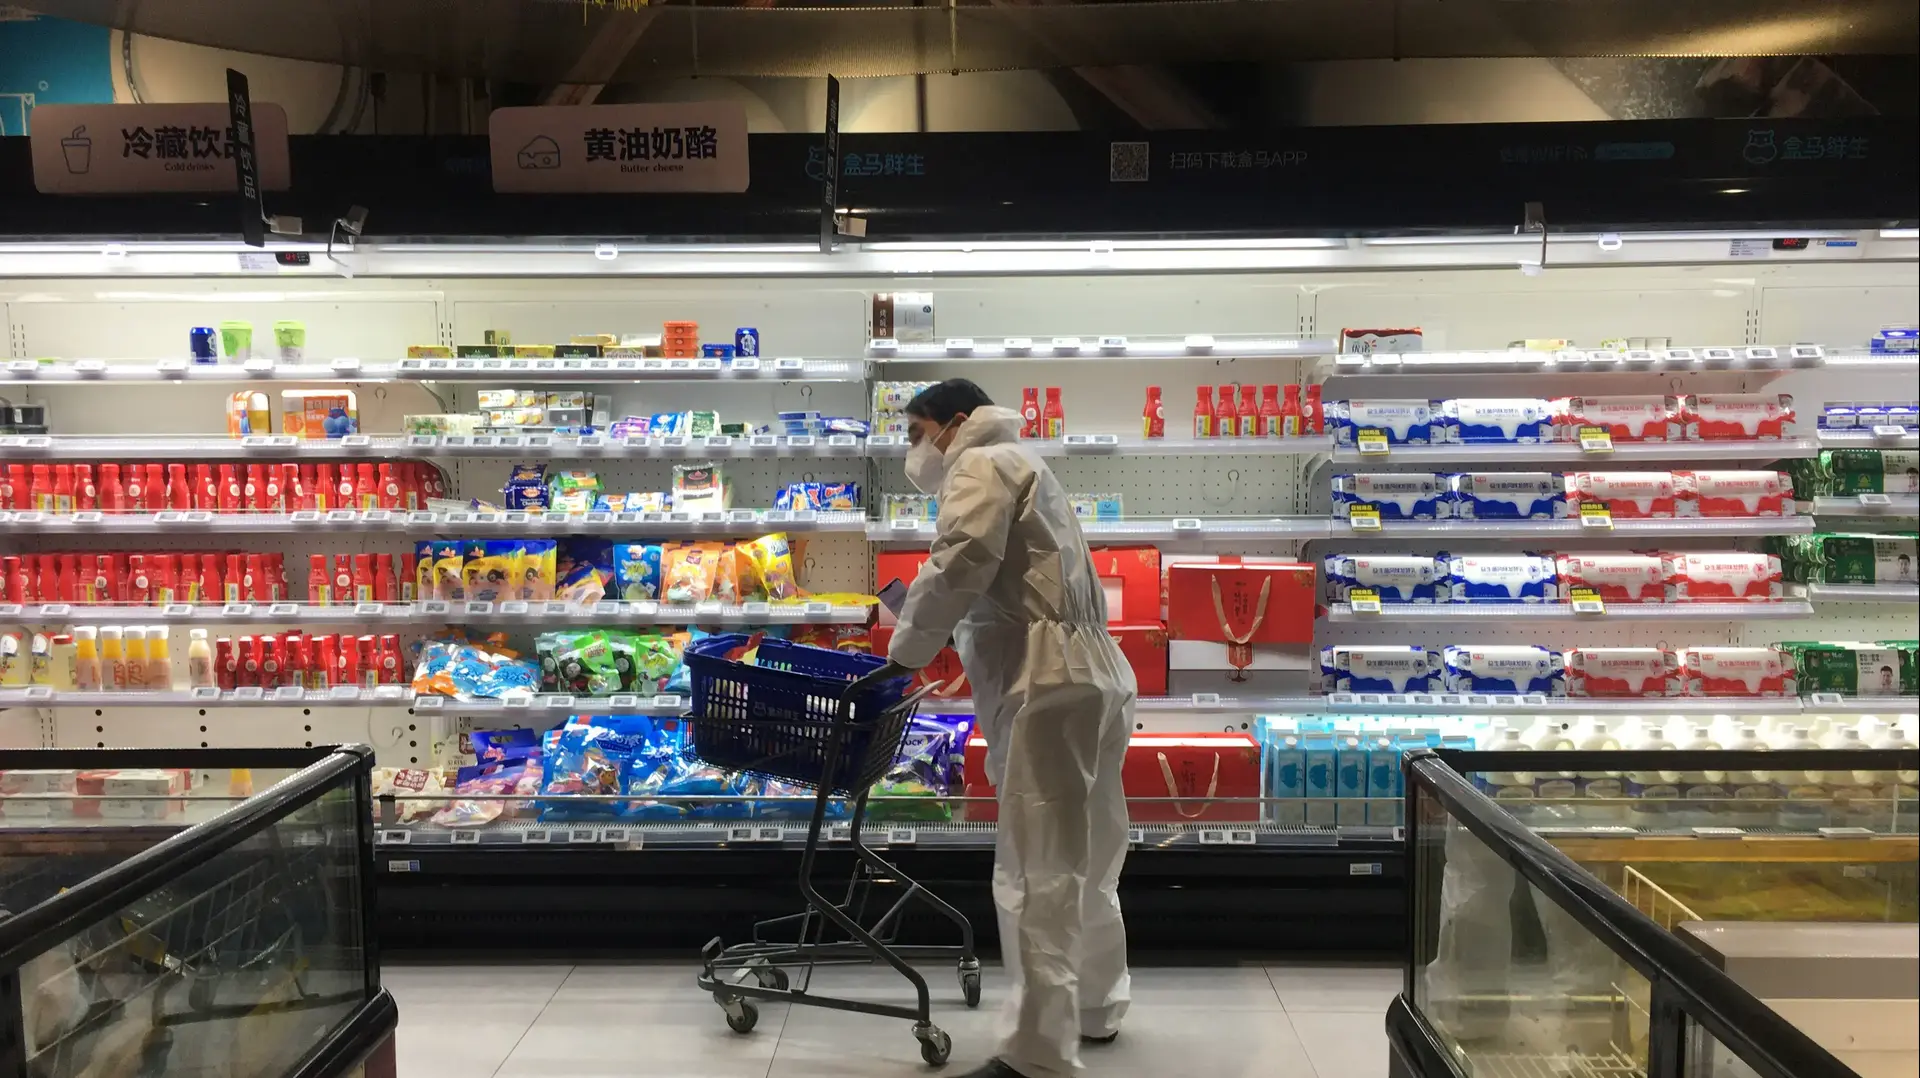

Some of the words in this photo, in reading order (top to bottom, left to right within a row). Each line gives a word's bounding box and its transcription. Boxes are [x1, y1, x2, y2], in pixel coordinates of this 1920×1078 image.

[584, 126, 718, 162] 黄油奶酪
[1780, 136, 1869, 160] 盒马鲜生
[165, 162, 184, 173] Cold
[621, 164, 651, 174] Butter
[653, 164, 685, 174] cheese
[843, 153, 926, 177] 盒马鲜生
[1170, 150, 1308, 169] 扫码下载盒马APP
